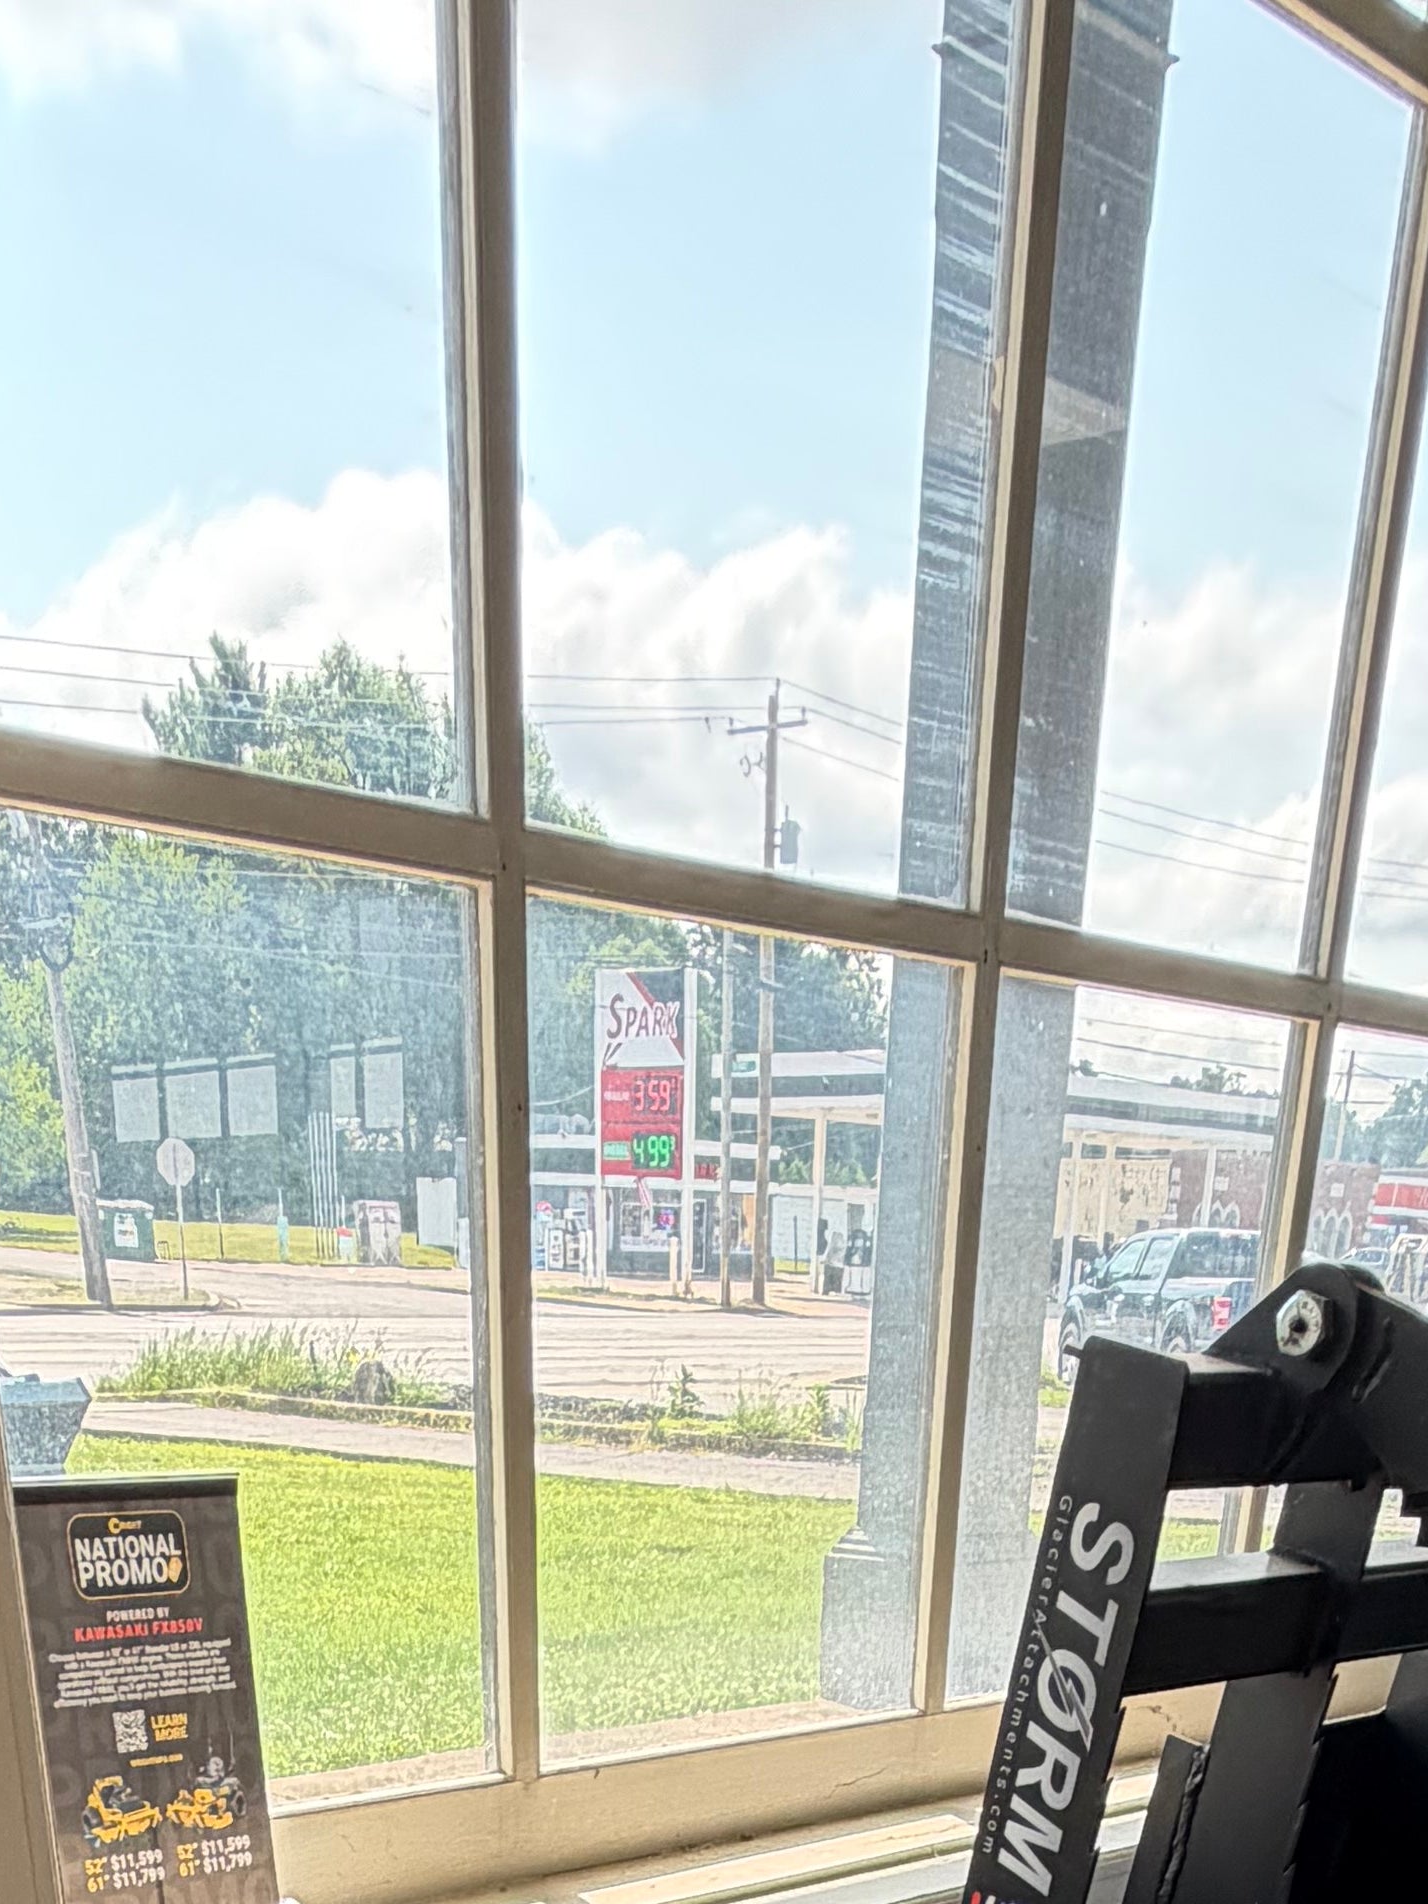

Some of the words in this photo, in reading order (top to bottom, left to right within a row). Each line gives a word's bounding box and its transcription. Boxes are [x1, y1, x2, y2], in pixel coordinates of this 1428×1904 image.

[606, 993, 680, 1038] SPARK
[74, 1533, 181, 1561] NATIONAL
[78, 1557, 168, 1588] PROMO
[107, 1607, 154, 1622] POWERED
[74, 1622, 149, 1642] KAWASAKI
[201, 1835, 251, 1856] $11,599
[110, 1849, 163, 1872] $11,599
[203, 1851, 253, 1874] $11,799
[113, 1866, 165, 1889] $11,799
